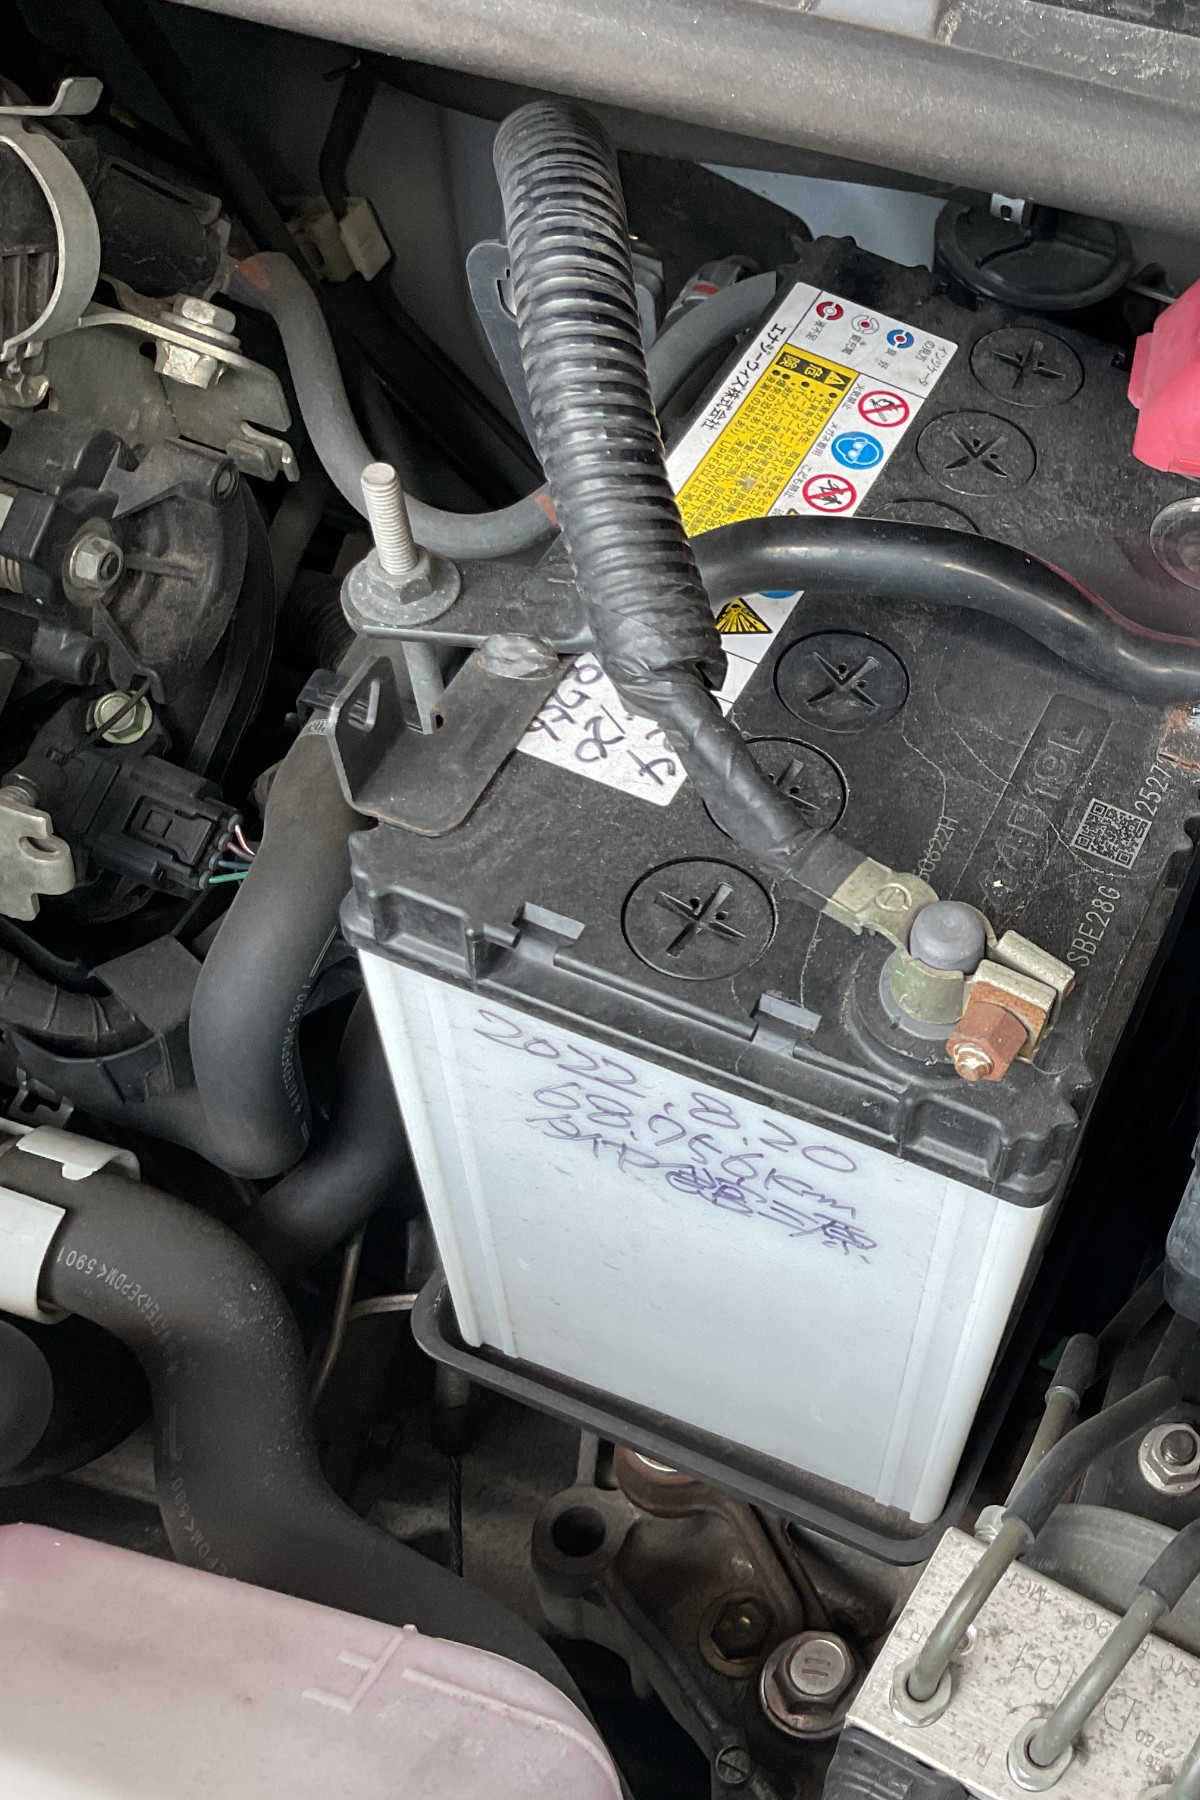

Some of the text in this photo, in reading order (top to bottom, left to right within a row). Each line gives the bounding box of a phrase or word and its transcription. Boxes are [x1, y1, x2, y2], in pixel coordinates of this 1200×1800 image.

[700, 322, 786, 433] エナジーウィズ株式会社
[778, 351, 824, 381] 危険
[1067, 885, 1121, 968] SBE28G
